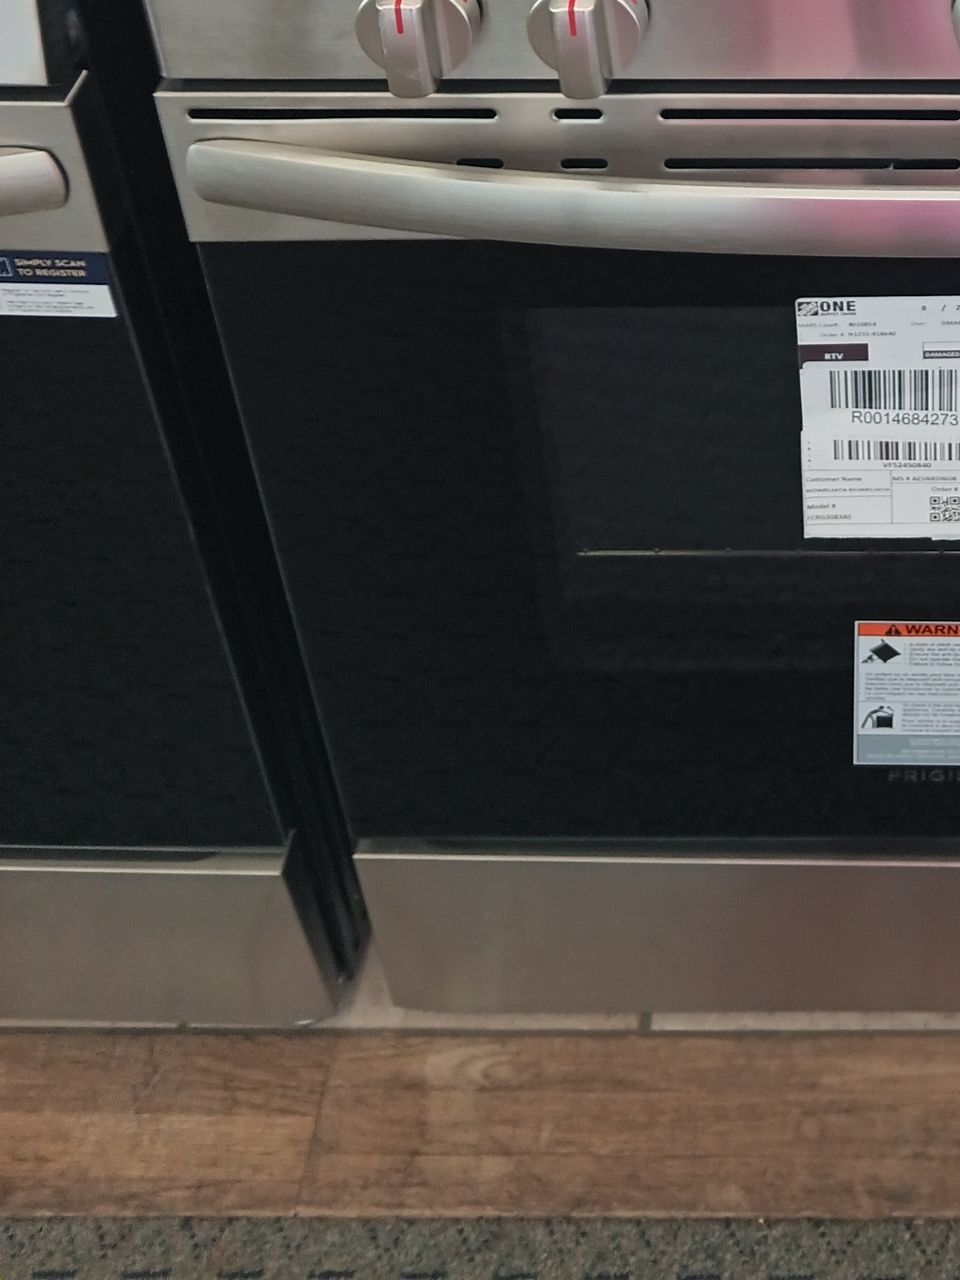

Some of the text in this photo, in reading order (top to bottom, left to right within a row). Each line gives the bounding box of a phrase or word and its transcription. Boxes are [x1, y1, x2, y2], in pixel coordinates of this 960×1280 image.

[14, 259, 86, 267] SIMPLY SCAN
[18, 269, 87, 278] TO REGISTER
[819, 300, 856, 312] ONE
[824, 352, 844, 360] RTV
[851, 410, 959, 426] R0014684273
